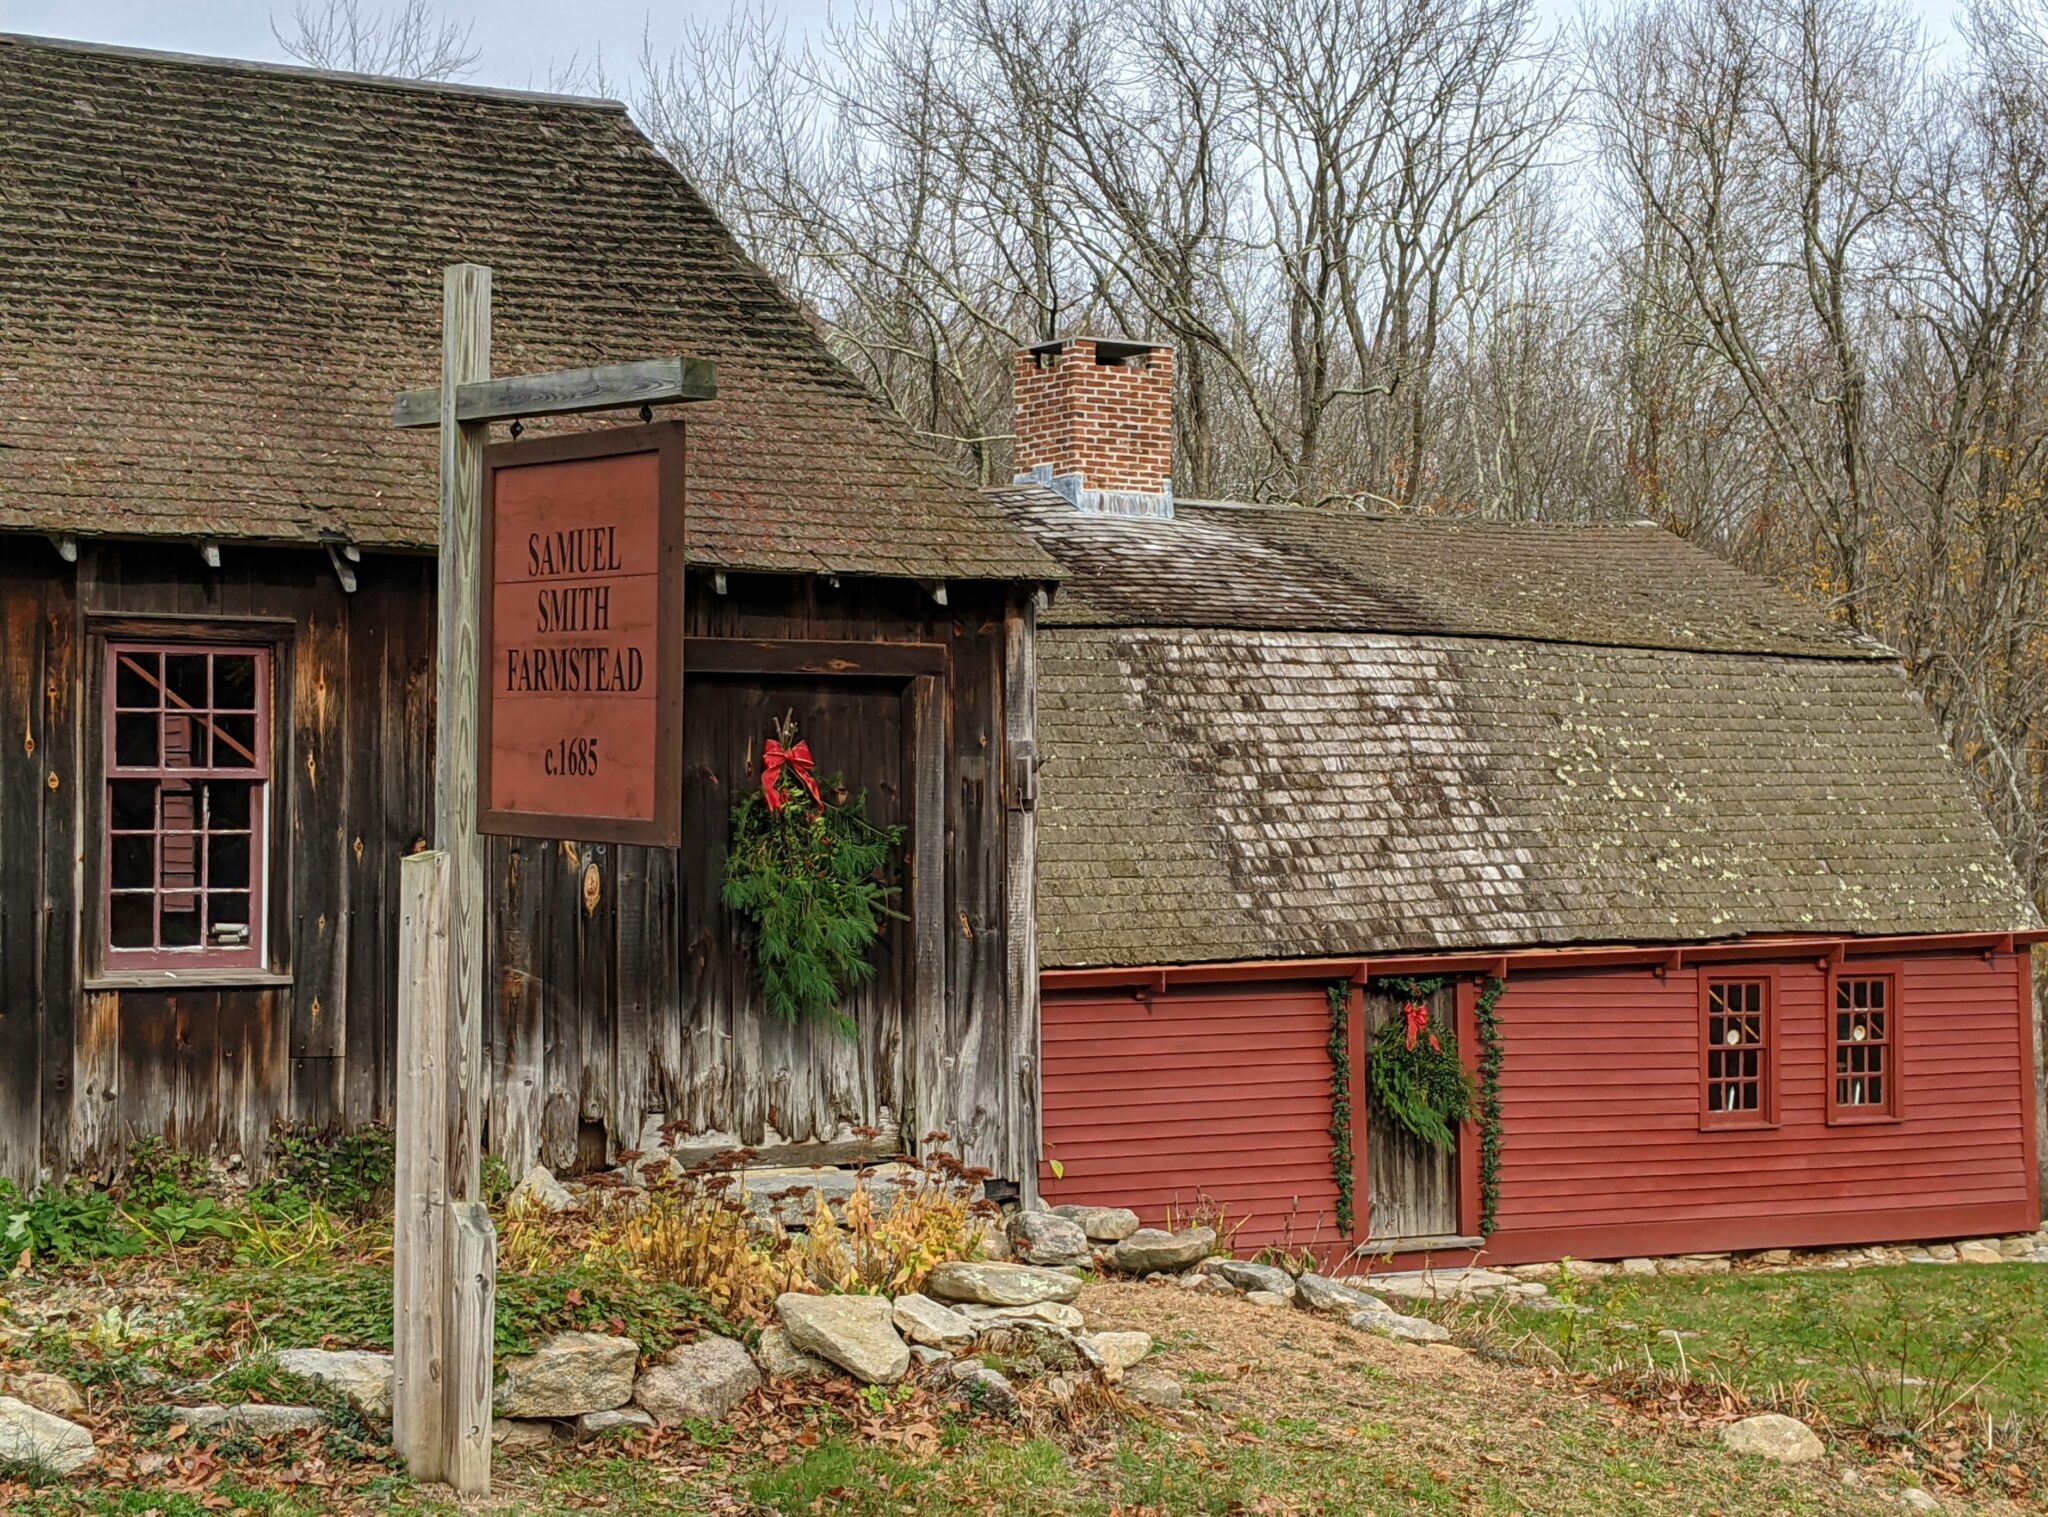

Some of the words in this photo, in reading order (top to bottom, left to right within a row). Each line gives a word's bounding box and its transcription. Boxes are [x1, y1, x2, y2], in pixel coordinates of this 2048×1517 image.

[528, 526, 621, 577] SAMUEL
[537, 586, 611, 633] SMITH
[506, 647, 643, 692] FARMSTEAD
[544, 737, 598, 776] c.1685
